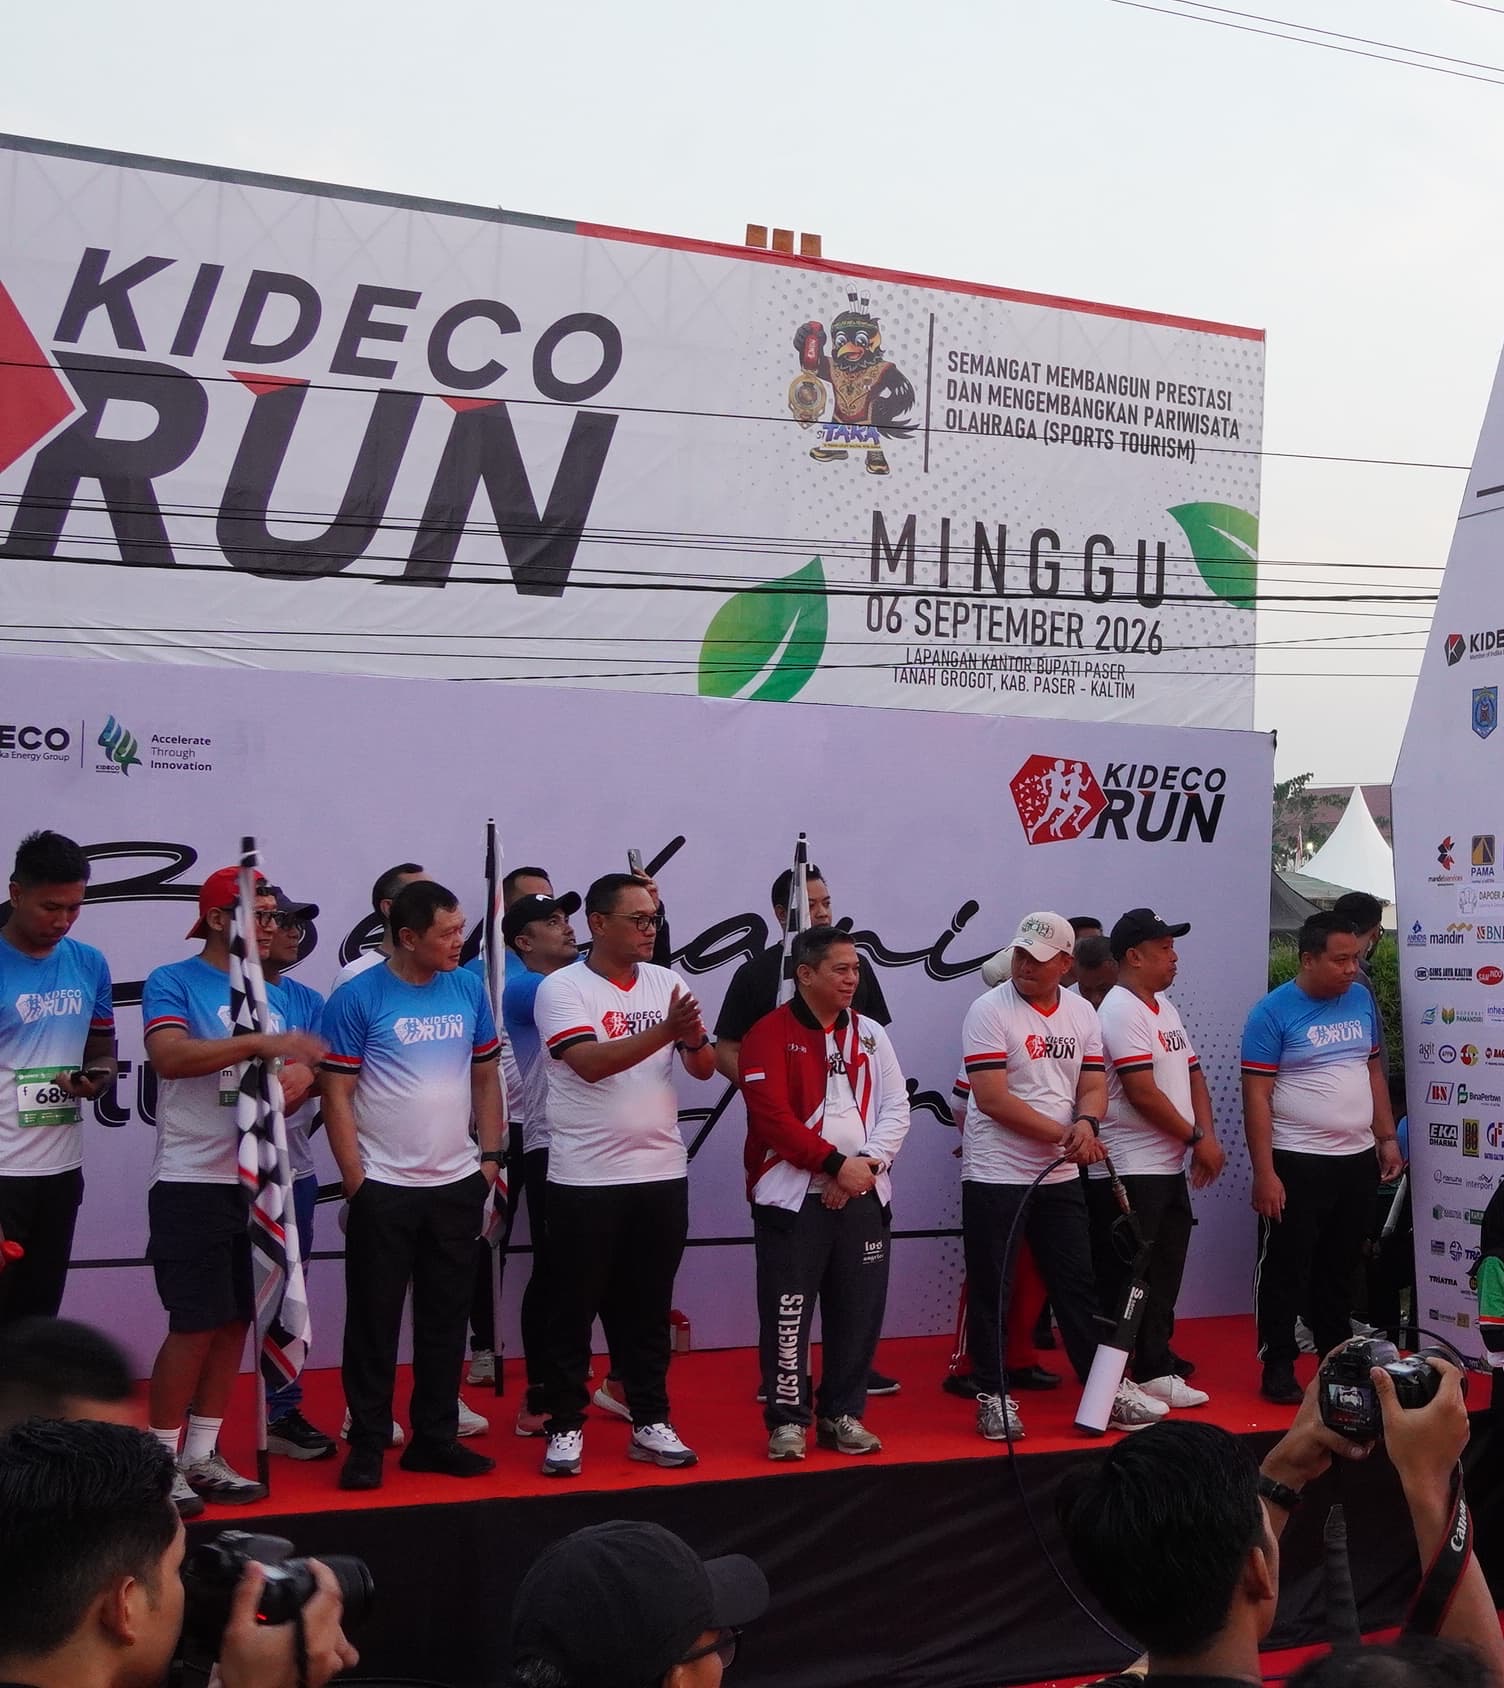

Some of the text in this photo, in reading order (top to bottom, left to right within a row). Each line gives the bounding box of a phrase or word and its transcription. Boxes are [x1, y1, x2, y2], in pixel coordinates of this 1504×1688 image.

[53, 247, 623, 403] KIDECO
[947, 350, 1232, 411] SEMANGAT MEMBANGUN PRESTASI
[947, 378, 1240, 439] DAN MENGEMBANGKAN PARIWISATA
[823, 424, 880, 445] TAKA
[946, 408, 1196, 464] OLAHRAGA (SPORTS TOURISM)
[0, 349, 619, 598] RUN
[870, 510, 1167, 608] MINGGU
[866, 595, 1163, 655] 06 SEPTEMBER 2026
[906, 647, 1125, 681] LAPANGAN KANTOR BUPATI PASER
[894, 667, 1135, 699] TANAH GROGOT, KAB. PASER KALTIM
[0, 725, 70, 751] ECO
[151, 734, 212, 746] Accelerate
[11, 752, 41, 761] Energy
[43, 753, 70, 762] Group
[151, 747, 196, 759] Through
[151, 760, 212, 771] Innovation
[1103, 763, 1227, 792] KIDECO
[1087, 789, 1225, 843] RUN
[1471, 867, 1495, 877] PAMA
[1429, 931, 1464, 945] mandiri
[1487, 925, 1504, 940] BNI
[44, 998, 82, 1016] RUN
[423, 1014, 463, 1024] KIDECO
[421, 1023, 463, 1041] RUN
[1331, 1025, 1363, 1043] RUN
[1044, 1044, 1075, 1059] RUN
[1430, 1124, 1457, 1138] EKA
[1430, 1139, 1458, 1148] DHARMA
[865, 1240, 883, 1251] los
[776, 1293, 804, 1406] LOS ANGELES
[1450, 1499, 1467, 1552] Canon
